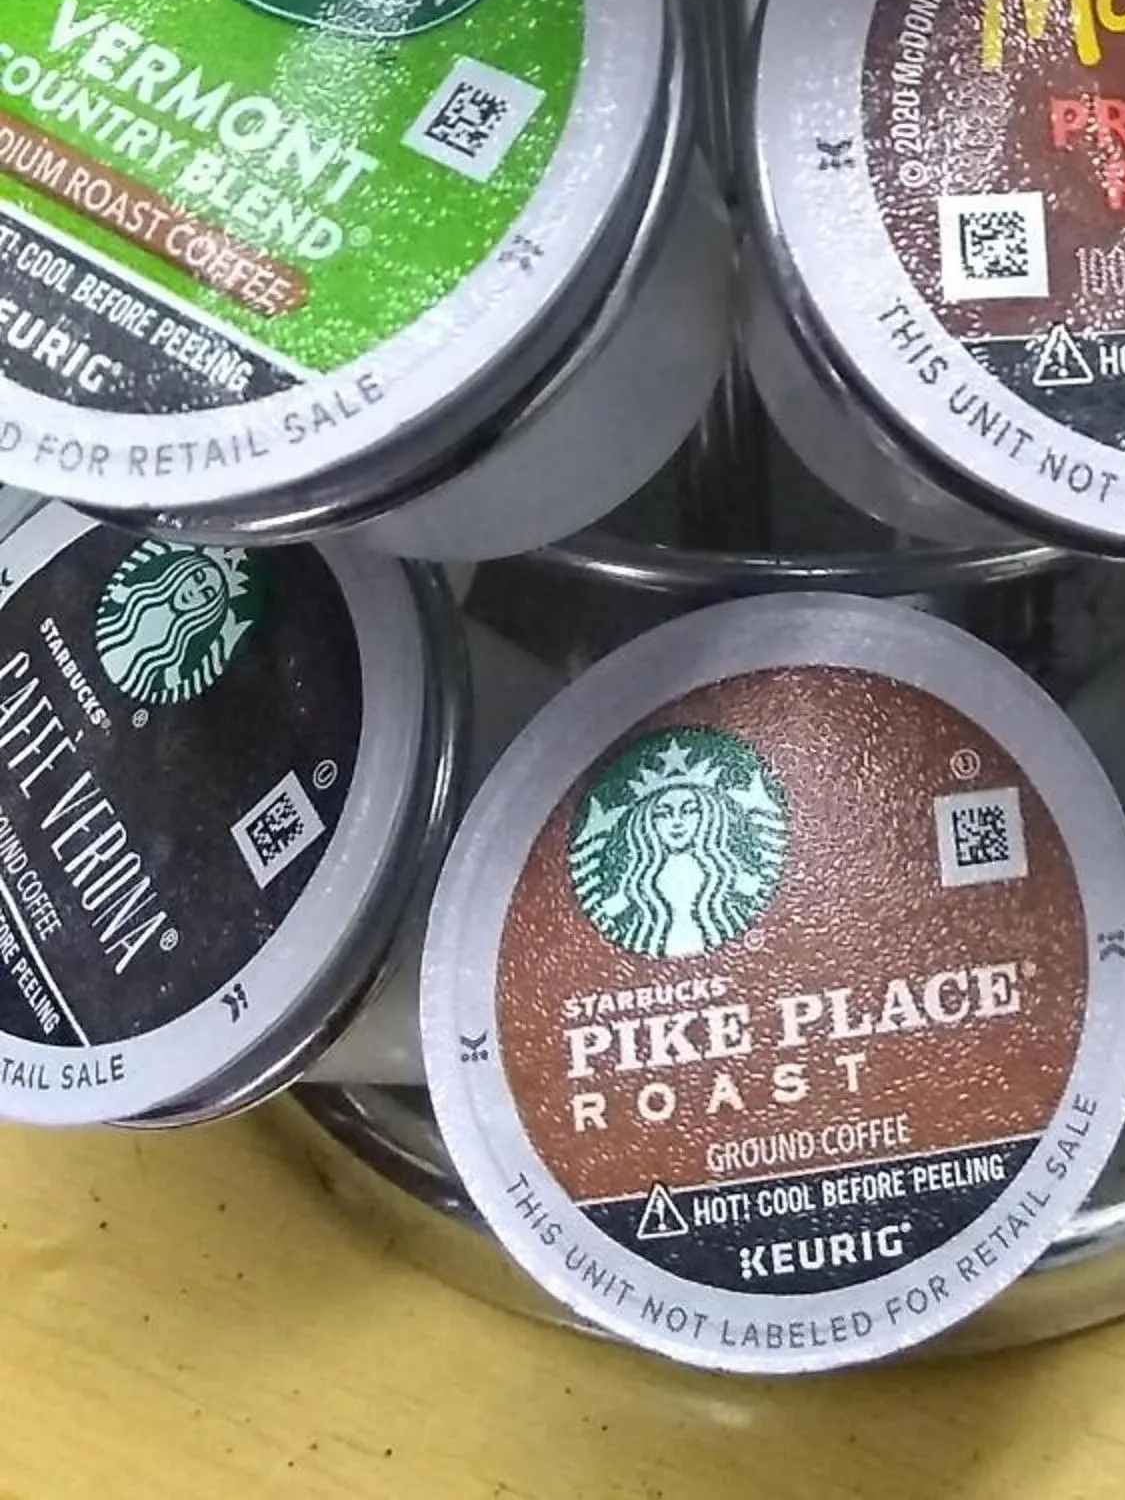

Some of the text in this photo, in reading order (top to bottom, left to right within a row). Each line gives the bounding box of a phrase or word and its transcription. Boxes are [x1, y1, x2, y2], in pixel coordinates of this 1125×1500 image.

[0, 126, 294, 313] DIUM ROAST COFFEE
[177, 147, 345, 261] BLEND
[0, 298, 112, 394] EURIG
[16, 240, 76, 294] COOL
[71, 274, 157, 340] BEFORE
[149, 317, 254, 393] PEELING
[34, 432, 110, 477] FOR
[129, 427, 270, 478] RETAIL
[283, 371, 387, 445] SALE
[876, 295, 940, 388] THIS
[947, 380, 1035, 463] UNIT
[1037, 443, 1120, 505] NOT
[39, 615, 108, 728] STARBUCKS
[16, 869, 63, 942] COFFEE
[11, 956, 62, 1036] PEELING
[562, 976, 730, 1020] STARBUCKS
[563, 962, 1023, 1081] PIKE PLACE
[0, 1052, 126, 1091] TAIL SALE
[571, 1052, 875, 1133] ROAST
[692, 1153, 1006, 1229] HOT! COOL BEFORE PEELING
[705, 1113, 912, 1175] GROUND COFFEE
[505, 1093, 1100, 1352] THIS UNIT NOT LABELED FOR RETAIL SALE
[739, 1228, 904, 1282] KEURIG
